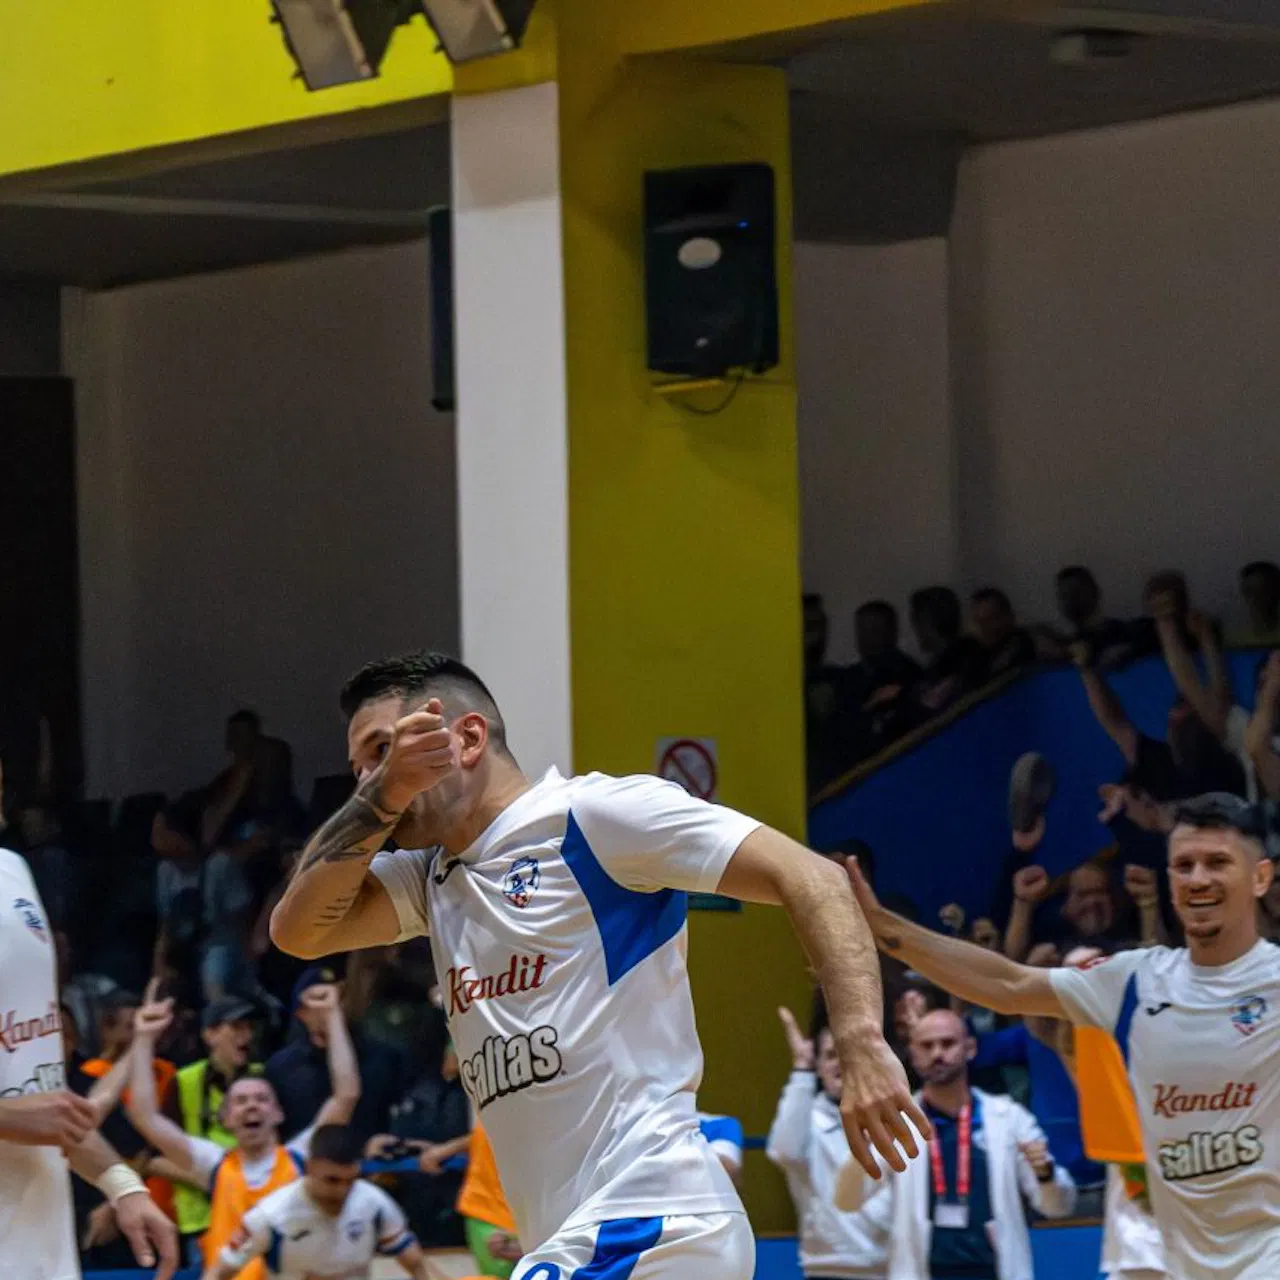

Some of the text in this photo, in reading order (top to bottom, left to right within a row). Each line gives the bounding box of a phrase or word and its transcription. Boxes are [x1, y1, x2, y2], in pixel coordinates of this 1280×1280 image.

[461, 1025, 562, 1110] saltas
[1153, 1081, 1257, 1118] Kandit
[1159, 1124, 1264, 1181] saltas
